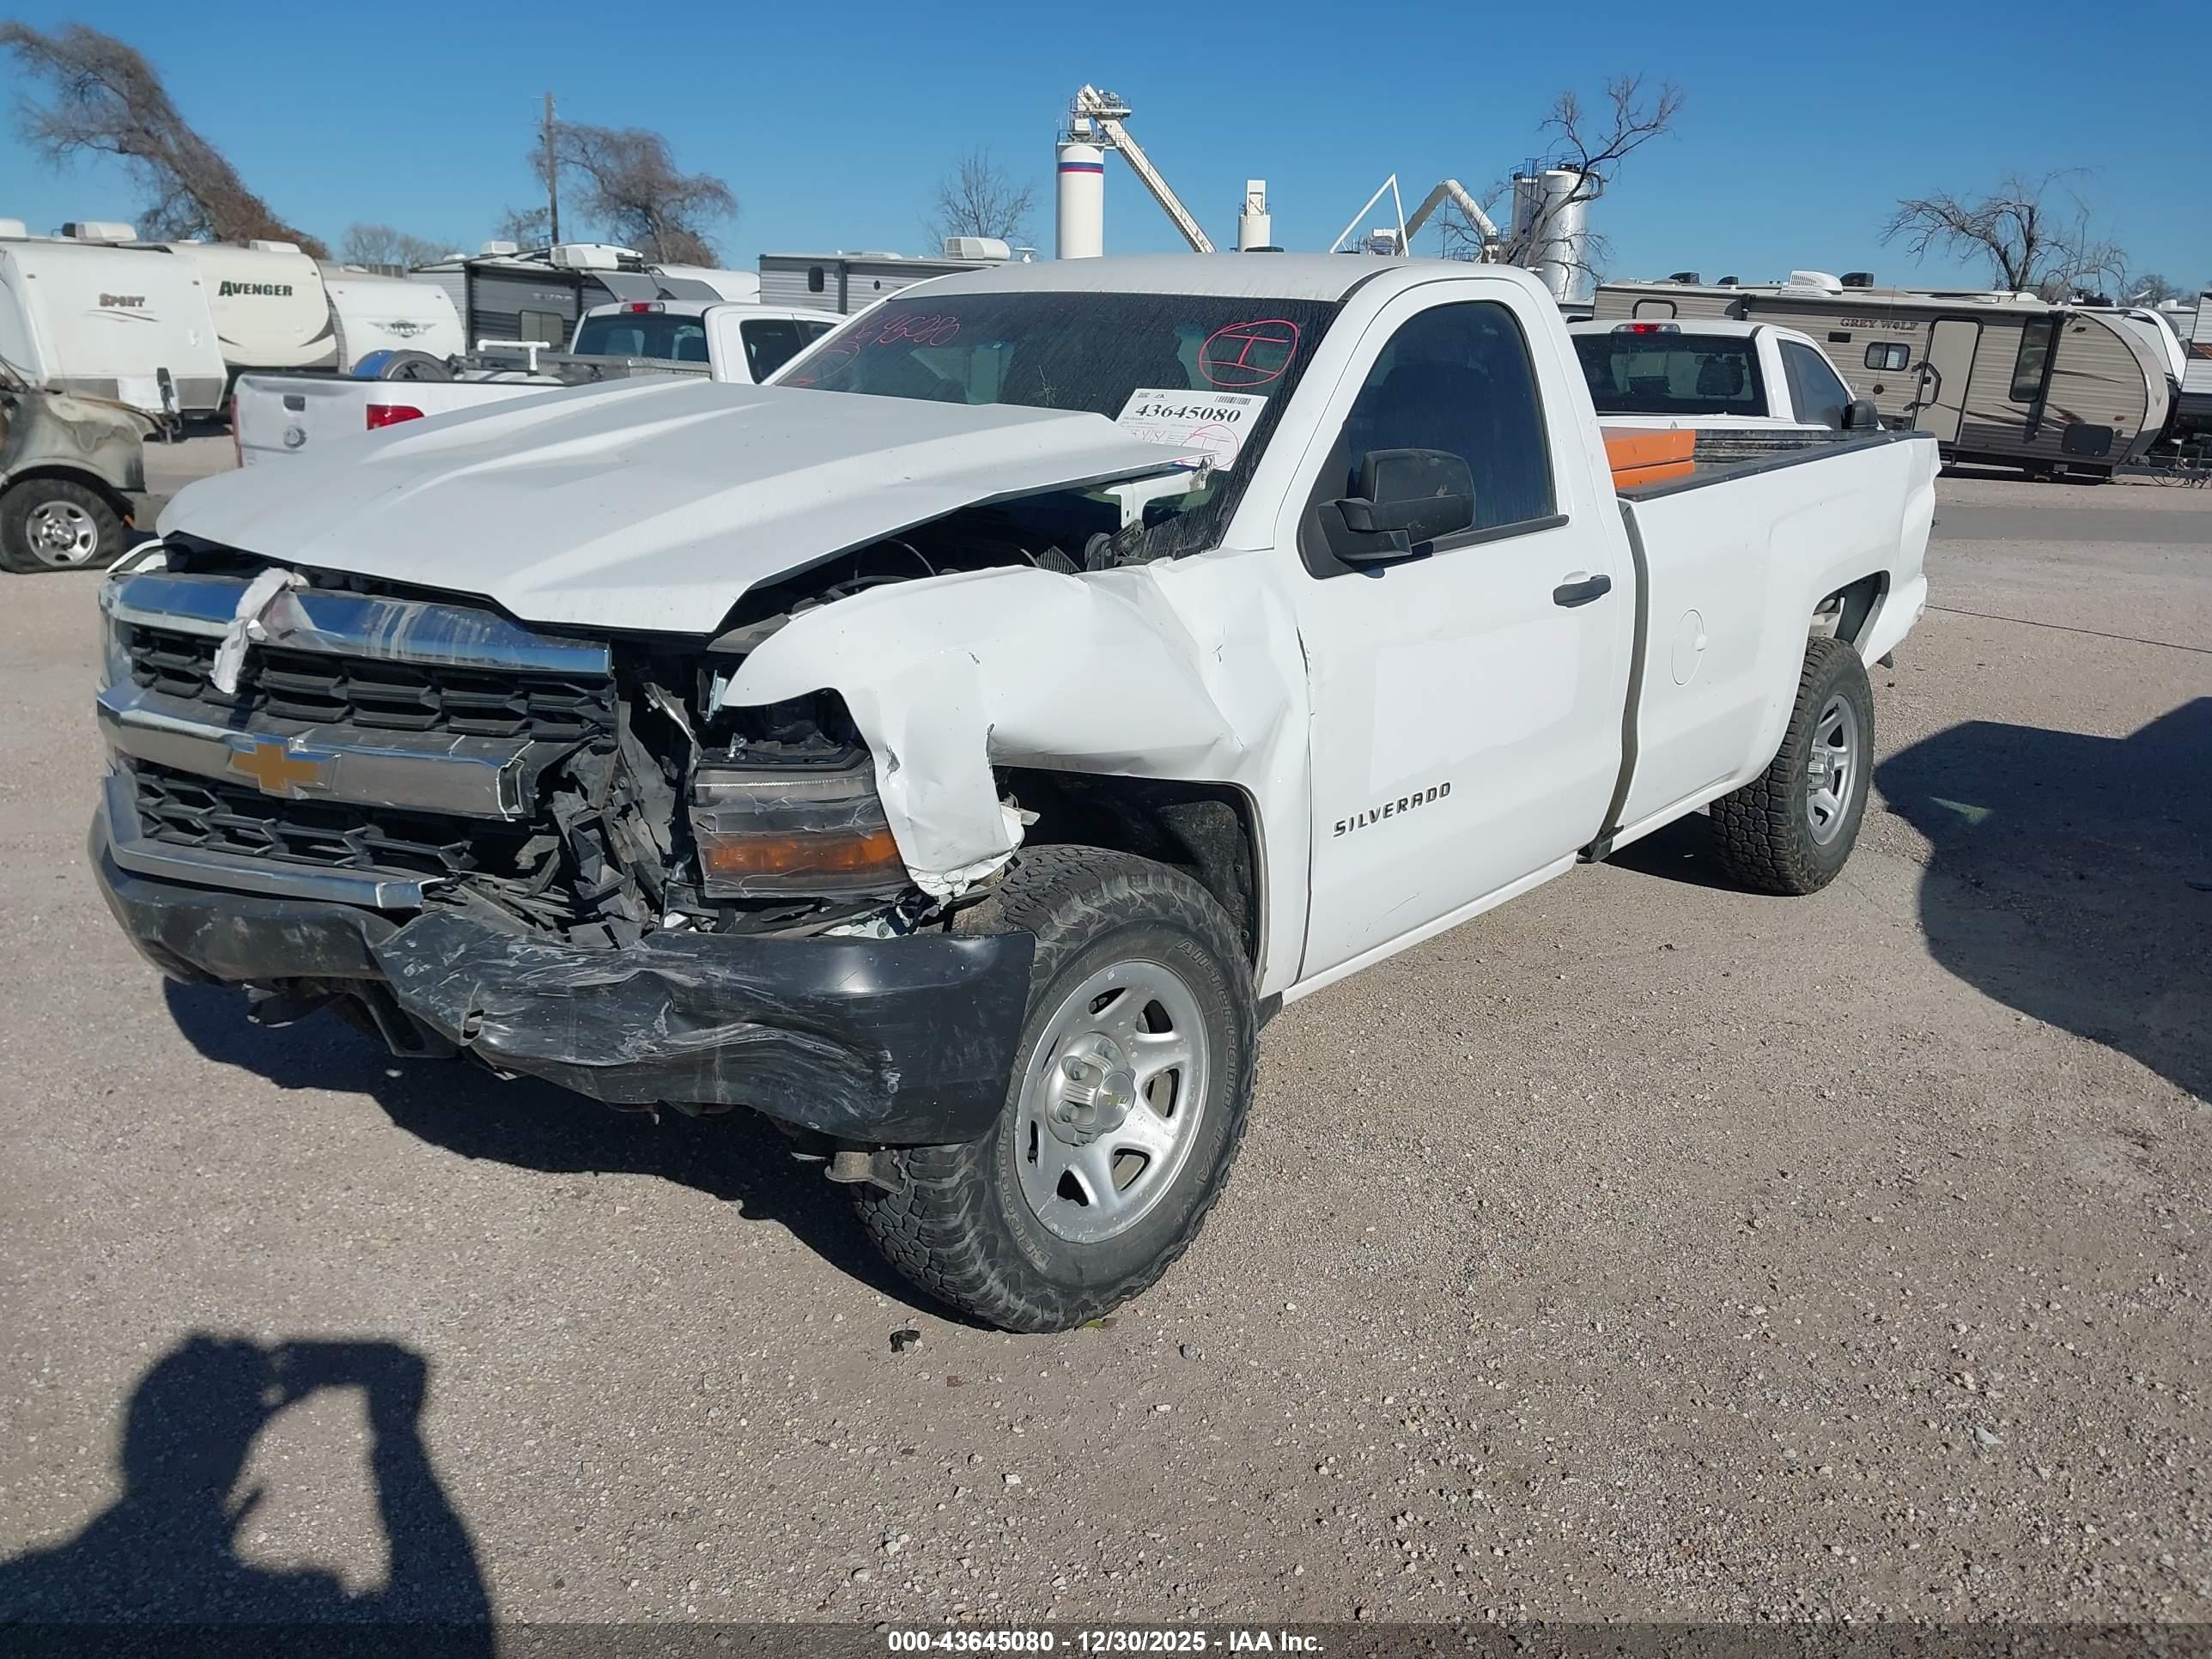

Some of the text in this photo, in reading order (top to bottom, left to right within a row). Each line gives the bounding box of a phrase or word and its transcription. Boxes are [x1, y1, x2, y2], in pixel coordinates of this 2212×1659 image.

[218, 280, 293, 297] AVENGER
[99, 293, 145, 307] SPORT
[1840, 318, 1918, 331] GREY WOLF
[1135, 404, 1242, 423] 43645080
[1333, 781, 1451, 838] SILVERADO
